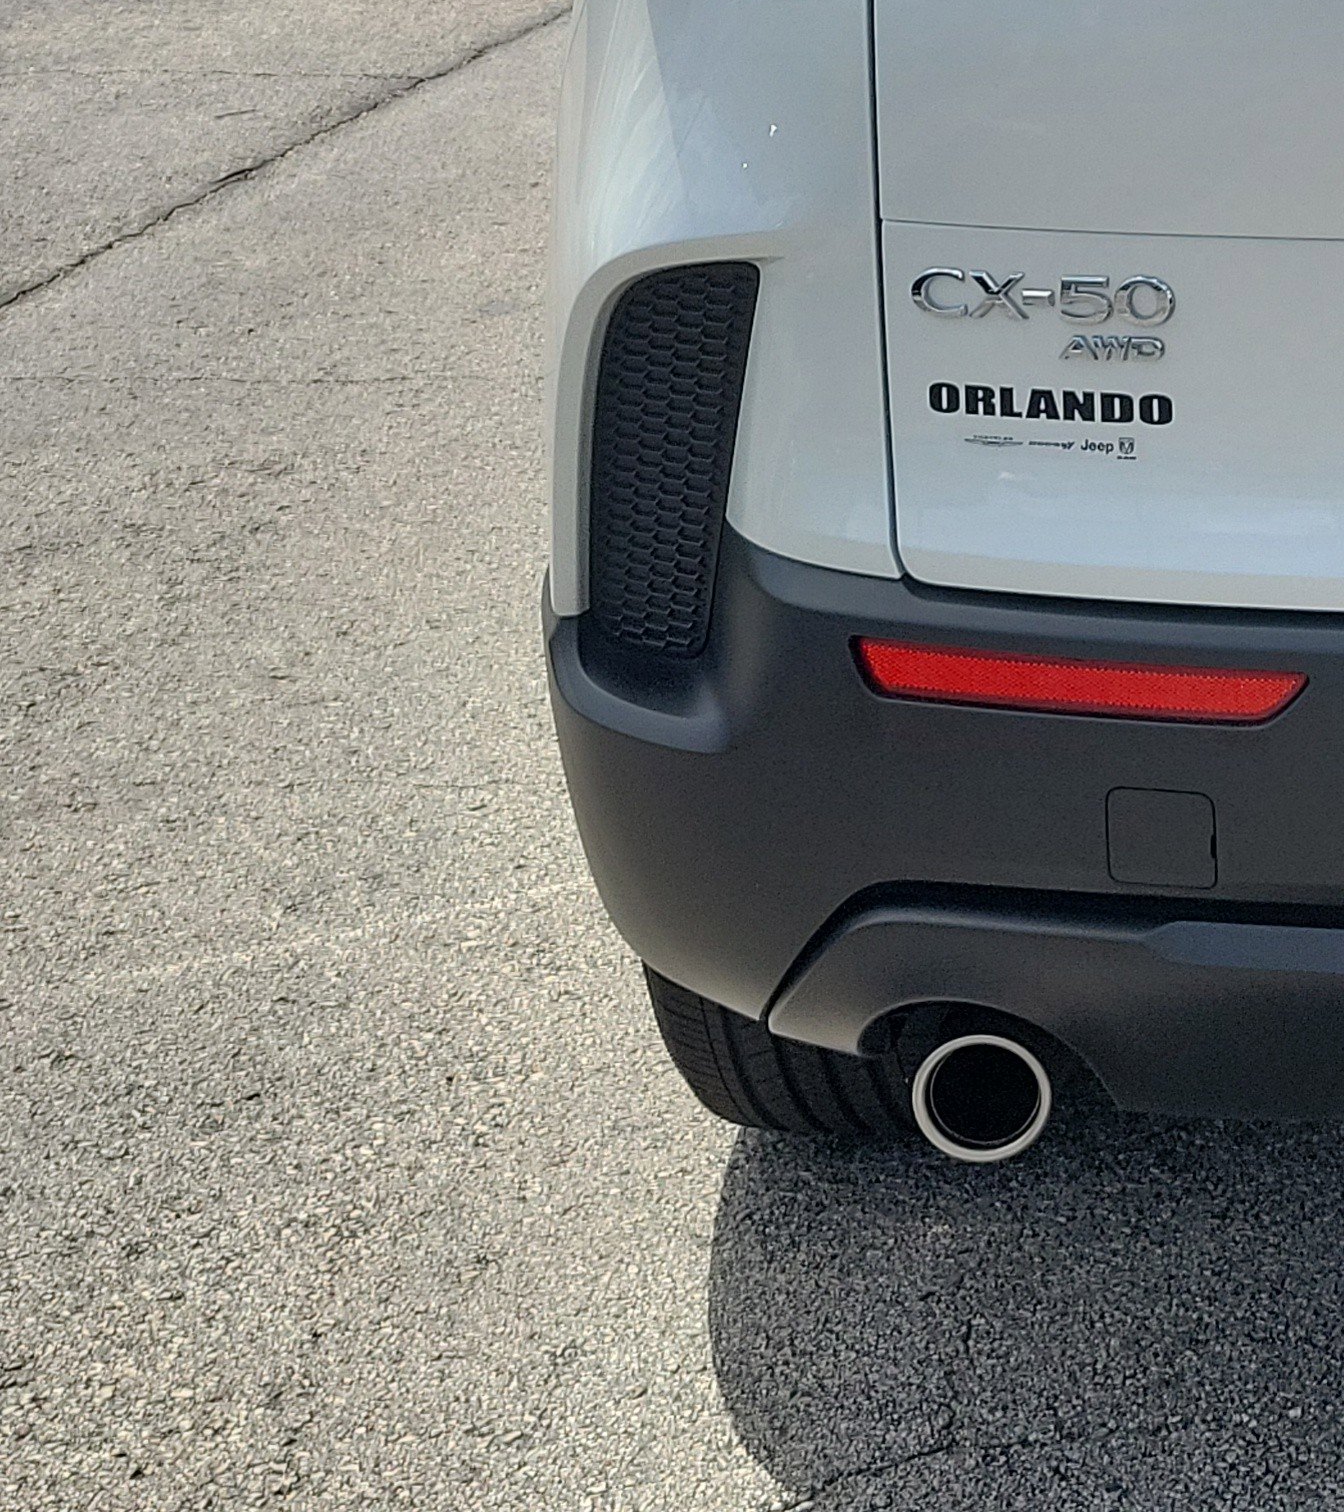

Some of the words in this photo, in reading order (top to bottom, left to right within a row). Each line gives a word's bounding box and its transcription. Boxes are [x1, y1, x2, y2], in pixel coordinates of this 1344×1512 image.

[911, 266, 1176, 327] CX-50
[1059, 334, 1166, 362] AWD
[928, 381, 1174, 426] ORLANDO
